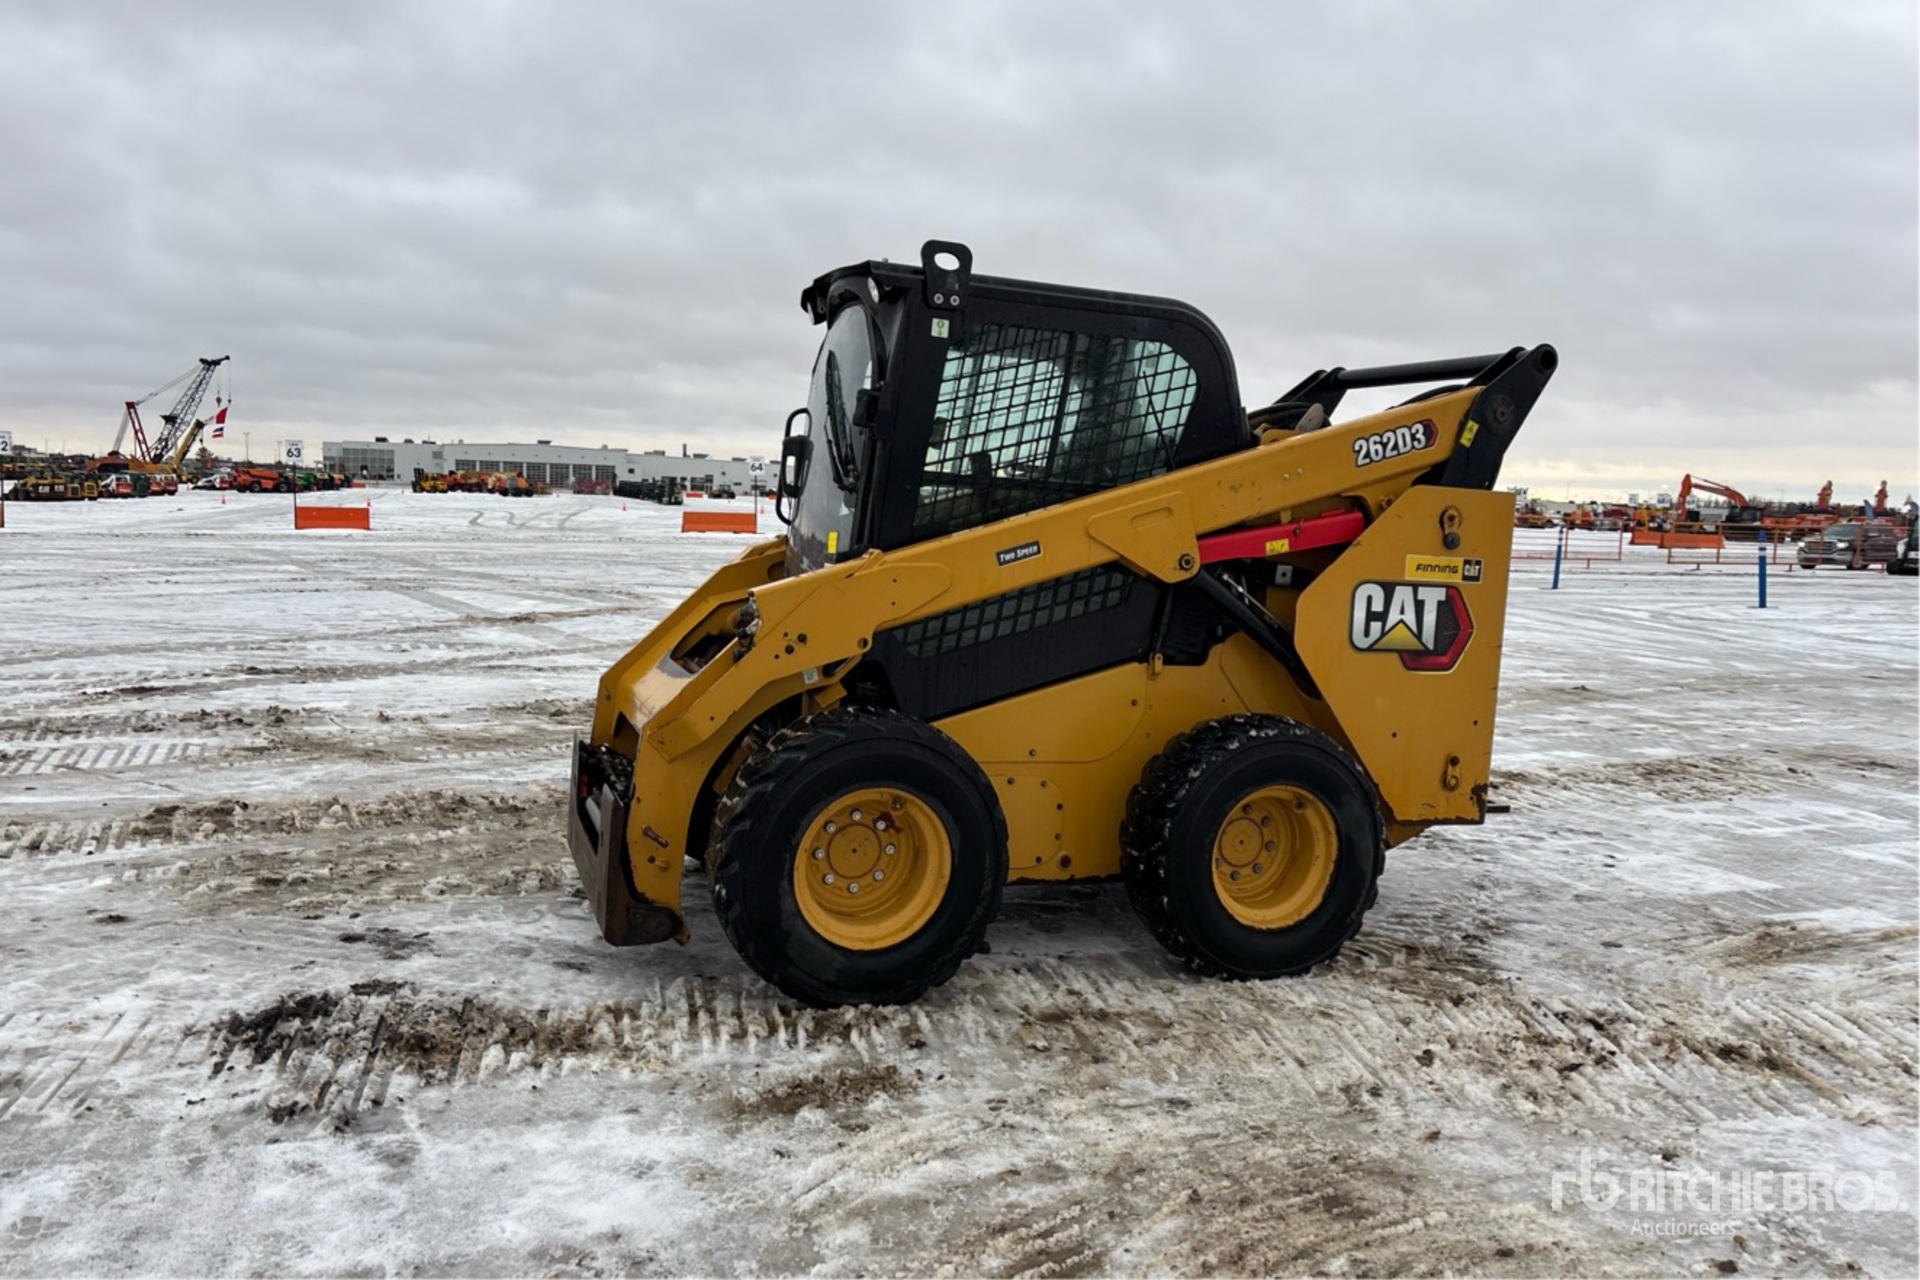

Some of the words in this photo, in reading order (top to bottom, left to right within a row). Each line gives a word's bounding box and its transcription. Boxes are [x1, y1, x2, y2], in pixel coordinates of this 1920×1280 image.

[1353, 422, 1427, 467] 262D3
[286, 447, 302, 458] 63
[750, 462, 763, 473] 64
[1415, 563, 1459, 574] FINNING
[1463, 564, 1480, 576] CAT
[1351, 583, 1447, 651] CAT
